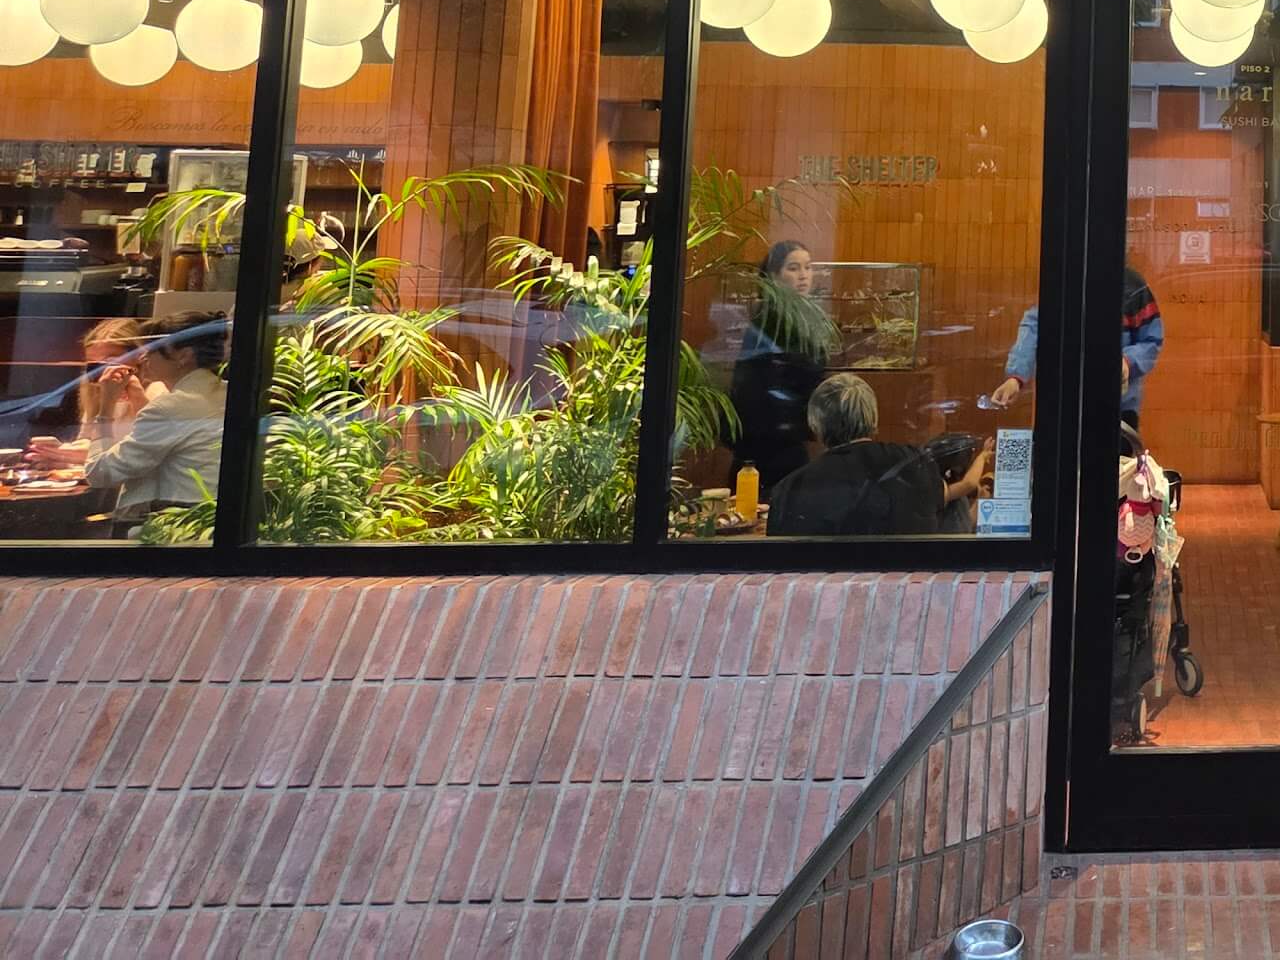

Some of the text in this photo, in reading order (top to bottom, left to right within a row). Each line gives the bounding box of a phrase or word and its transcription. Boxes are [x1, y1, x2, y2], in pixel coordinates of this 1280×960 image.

[1240, 65, 1272, 74] PISO 2
[1221, 116, 1258, 128] SUSHI
[799, 154, 939, 185] THE SHELTER
